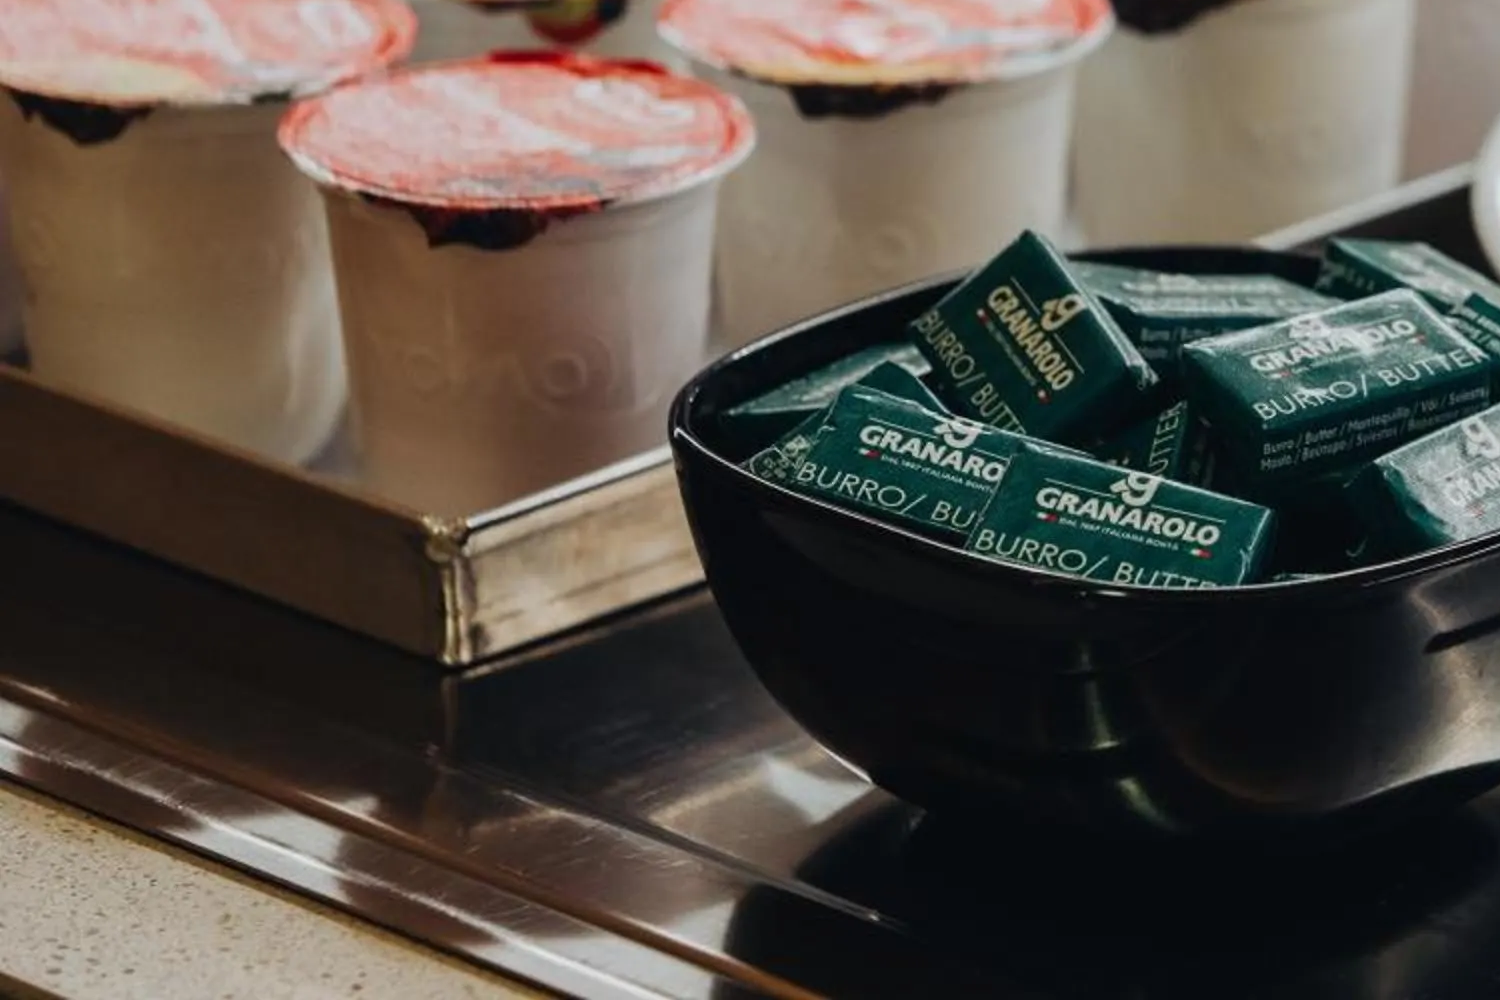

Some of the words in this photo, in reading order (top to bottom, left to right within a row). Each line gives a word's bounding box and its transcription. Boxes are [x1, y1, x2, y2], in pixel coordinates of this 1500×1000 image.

[911, 309, 985, 388] BURRO/
[988, 286, 1074, 390] GRANAROLO
[1251, 320, 1417, 371] GRANAOLO
[1378, 346, 1490, 387] BUTTER
[860, 425, 1004, 482] GRANARO
[797, 463, 926, 514] BURRO/
[1035, 487, 1221, 546] GRANAROLO
[974, 529, 1109, 578] BURRO/
[1114, 561, 1217, 587] BUTT
